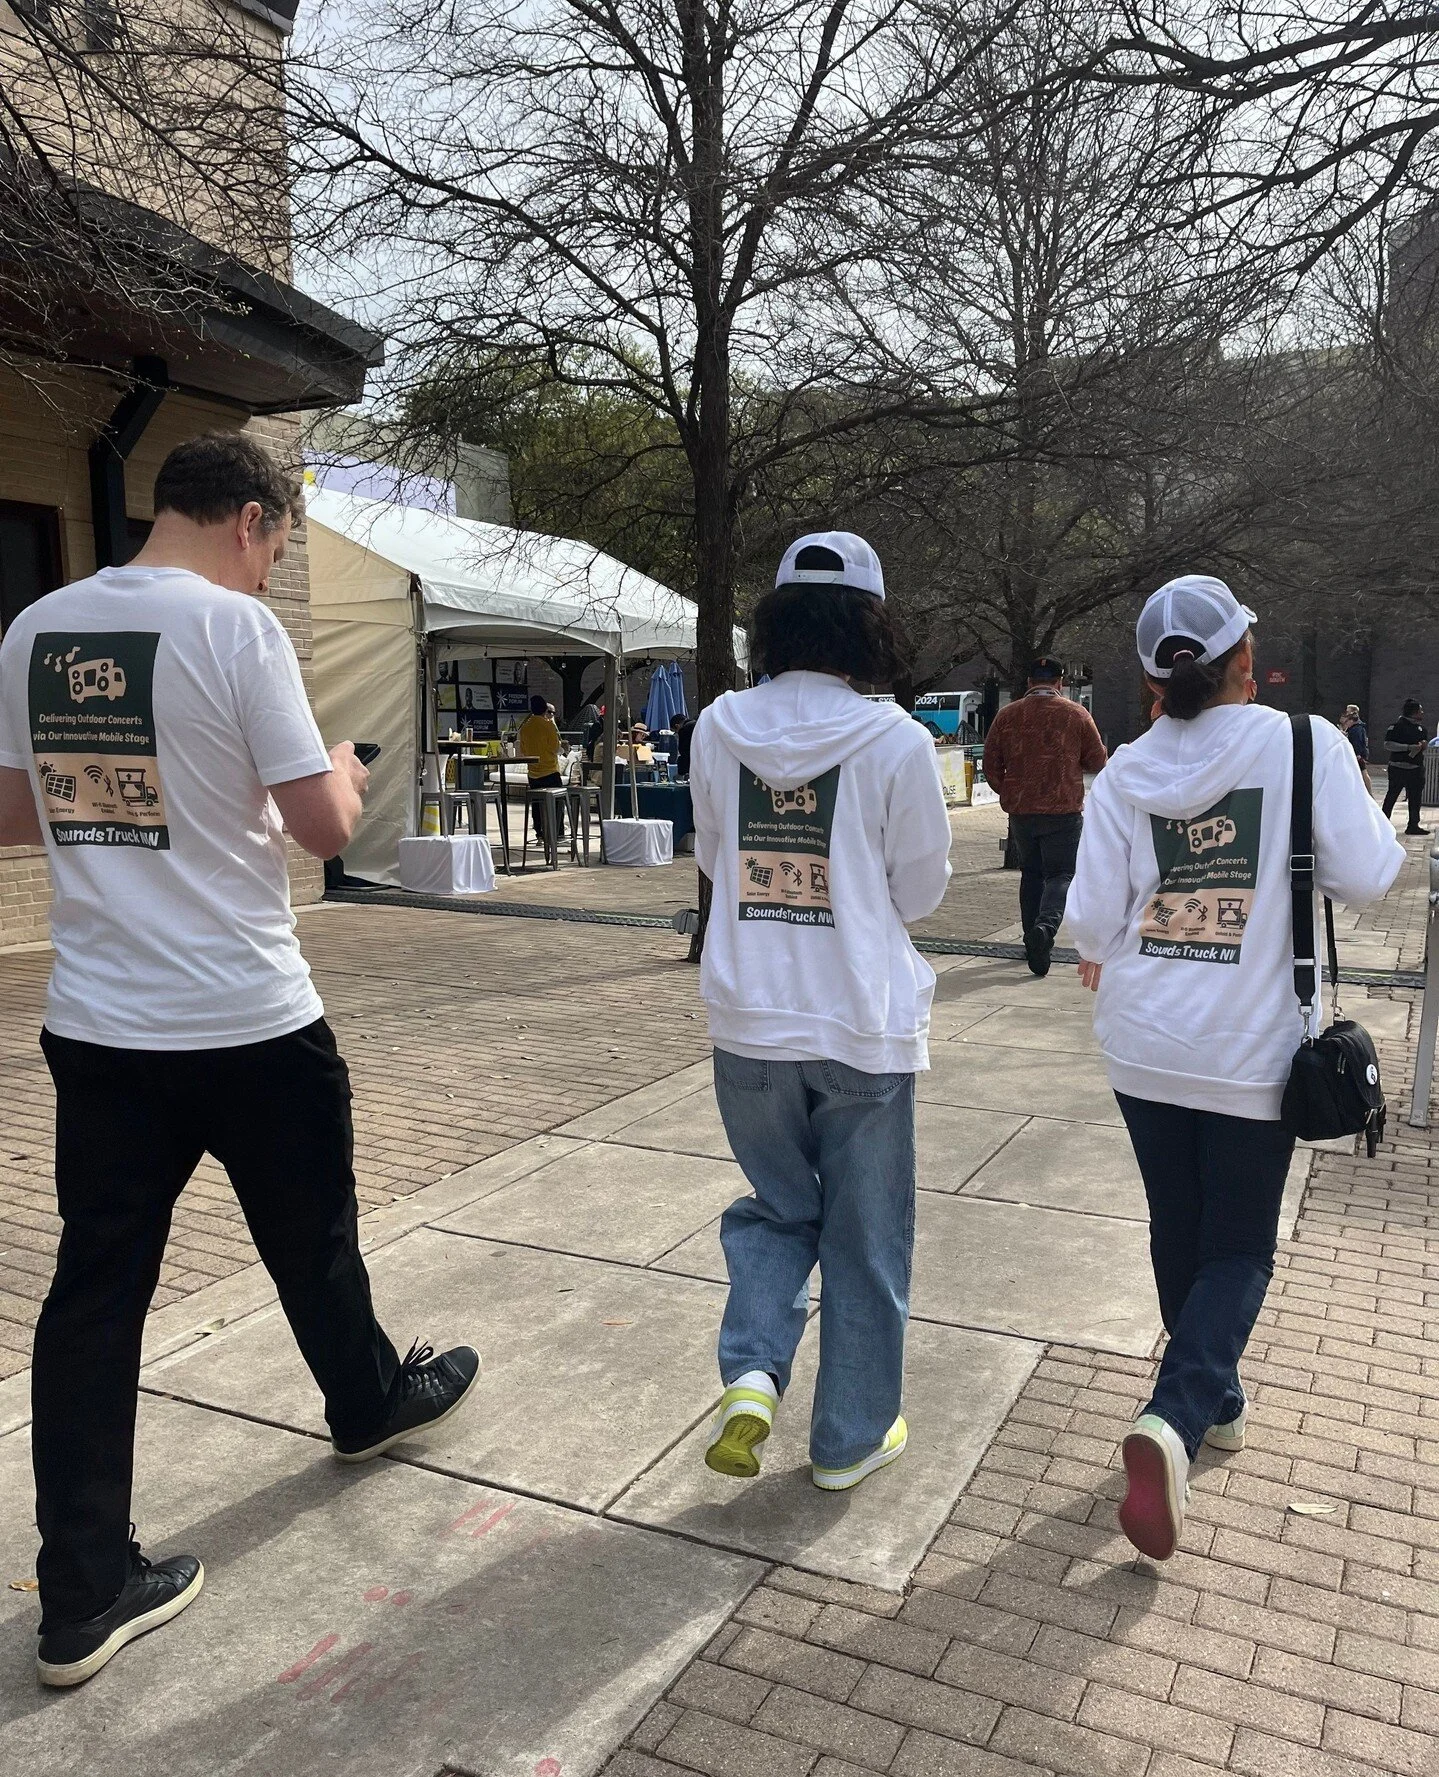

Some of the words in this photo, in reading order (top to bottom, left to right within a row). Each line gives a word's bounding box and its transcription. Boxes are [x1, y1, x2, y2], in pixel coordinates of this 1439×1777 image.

[915, 696, 938, 705] 2024
[39, 713, 76, 725] Delivering
[77, 713, 107, 724] Outdoor
[108, 714, 143, 725] Concerts
[33, 731, 46, 741] via
[48, 731, 63, 741] Our
[63, 731, 98, 741] Innovative
[99, 731, 123, 743] Mobile
[124, 733, 150, 745] Stage
[748, 821, 777, 832] Delivering
[778, 822, 805, 831] Outdoor
[742, 833, 753, 842] via
[767, 835, 796, 844] Innovative
[1216, 857, 1248, 866] Concerts
[1206, 870, 1229, 880] Mobile
[1230, 870, 1252, 881] Stage
